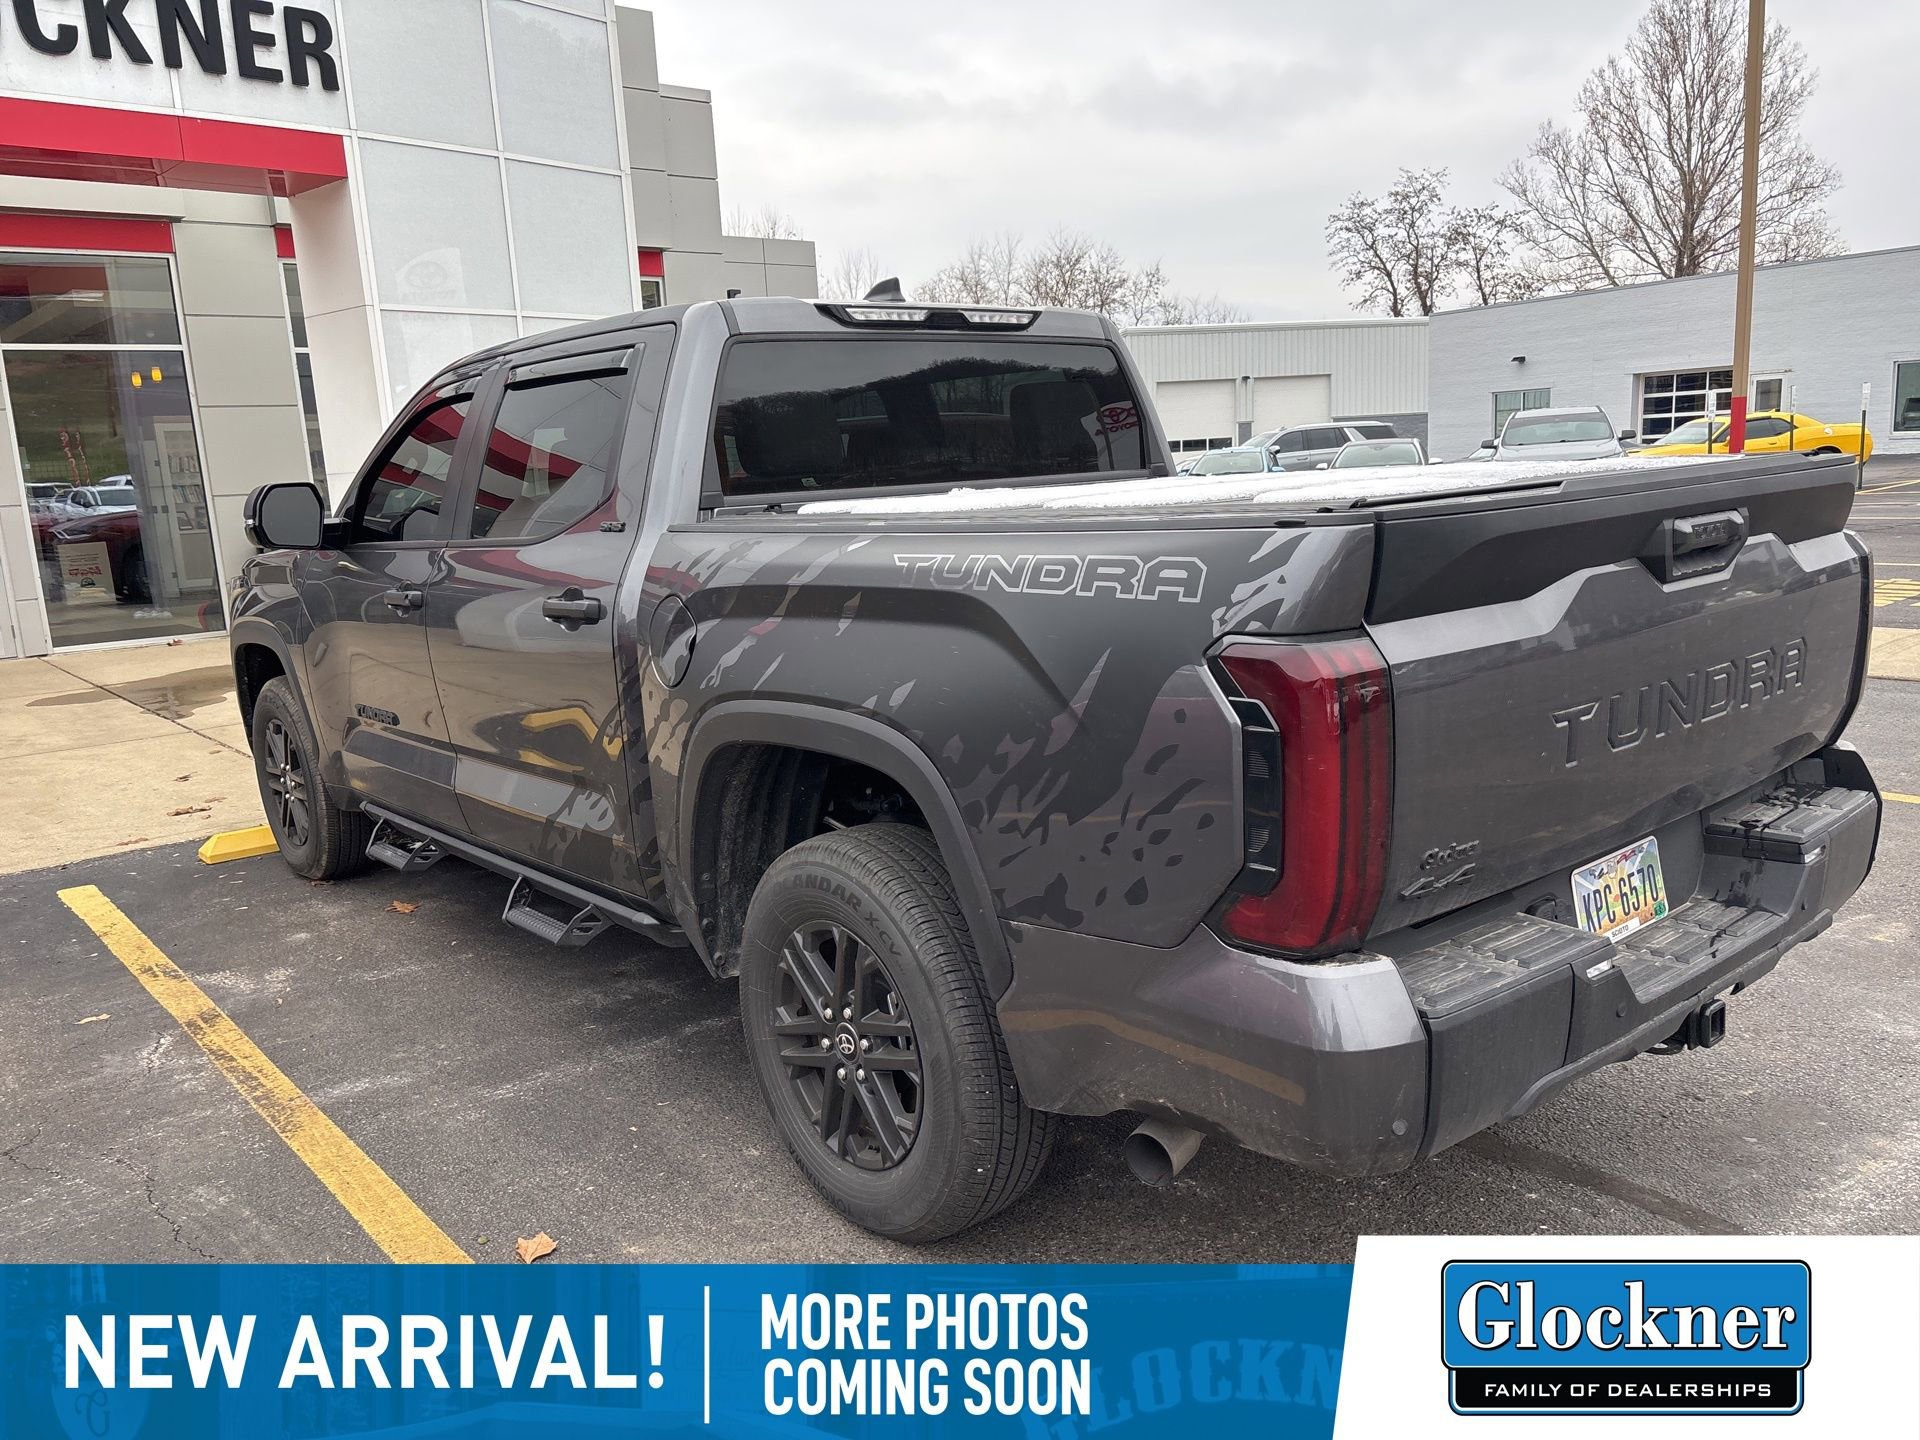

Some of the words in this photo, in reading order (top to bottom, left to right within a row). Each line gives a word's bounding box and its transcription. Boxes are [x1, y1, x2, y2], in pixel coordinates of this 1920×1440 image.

[893, 553, 1207, 603] TUNDRA
[355, 703, 400, 726] TUNDRA
[1552, 636, 1808, 768] TUNDRA
[1582, 883, 1617, 933] KPC
[1618, 863, 1659, 917] 6570
